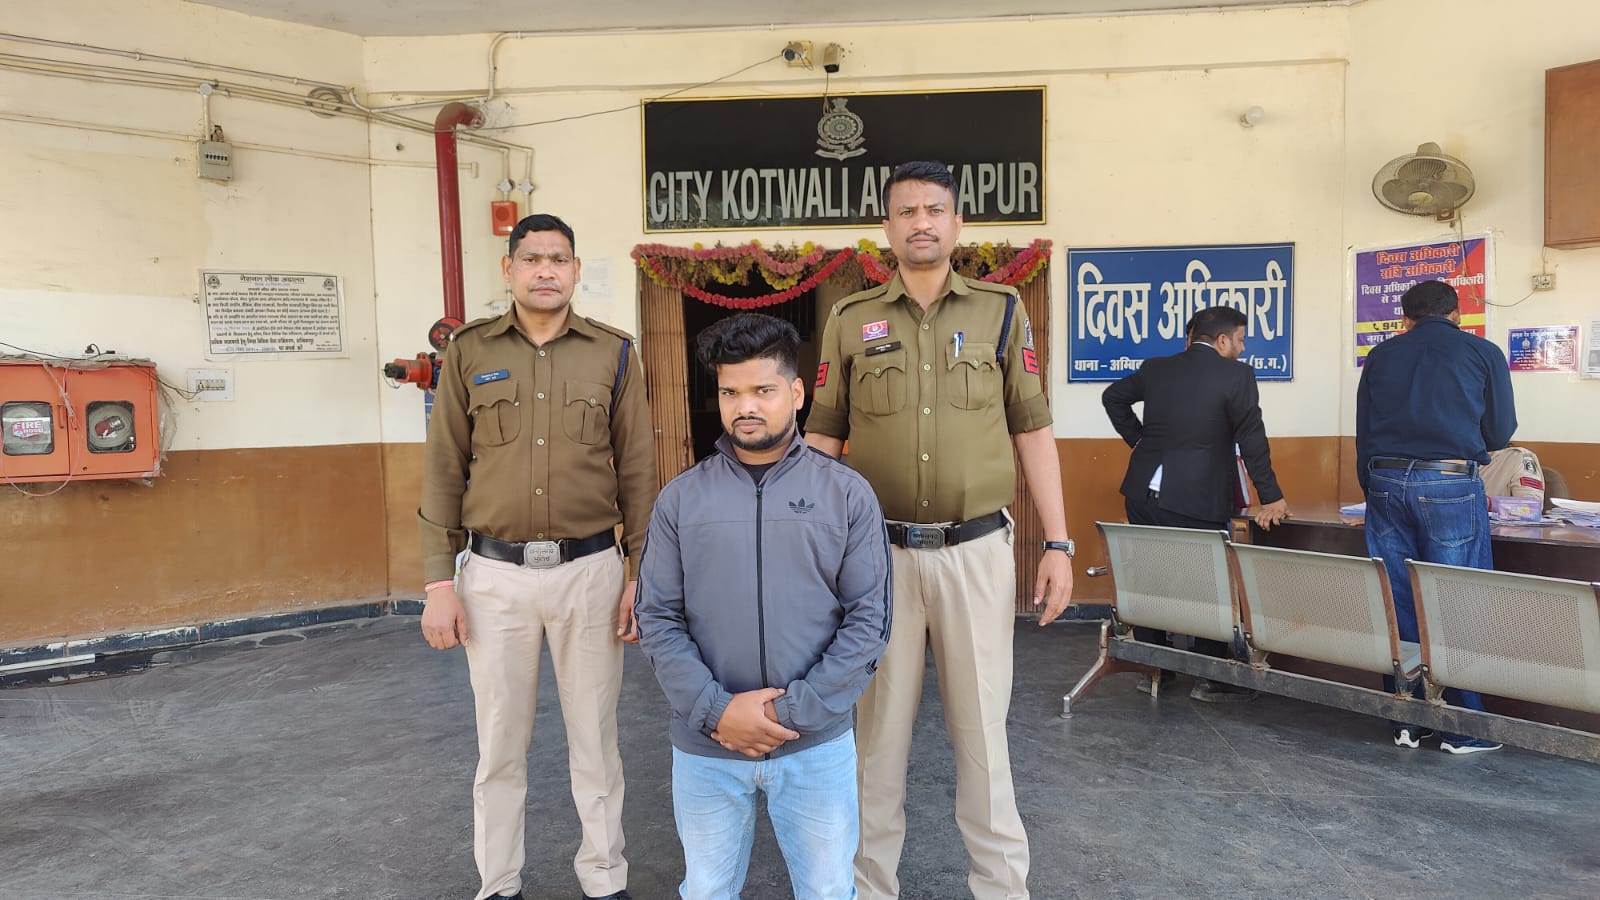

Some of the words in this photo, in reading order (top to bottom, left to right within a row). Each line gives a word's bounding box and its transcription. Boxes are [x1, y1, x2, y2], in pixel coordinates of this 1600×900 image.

[650, 170, 713, 223] CITY
[722, 167, 849, 221] KOTWALI
[859, 162, 1038, 217] AAPUR
[1377, 251, 1407, 265] दिवस
[1409, 243, 1460, 262] अधिकारी
[1381, 265, 1403, 280] रात्रि
[1405, 258, 1457, 277] अधिकारी
[1361, 284, 1381, 295] दिवस
[1077, 261, 1151, 345] दिवस
[1074, 359, 1100, 372] थाना
[12, 421, 43, 430] FIRE
